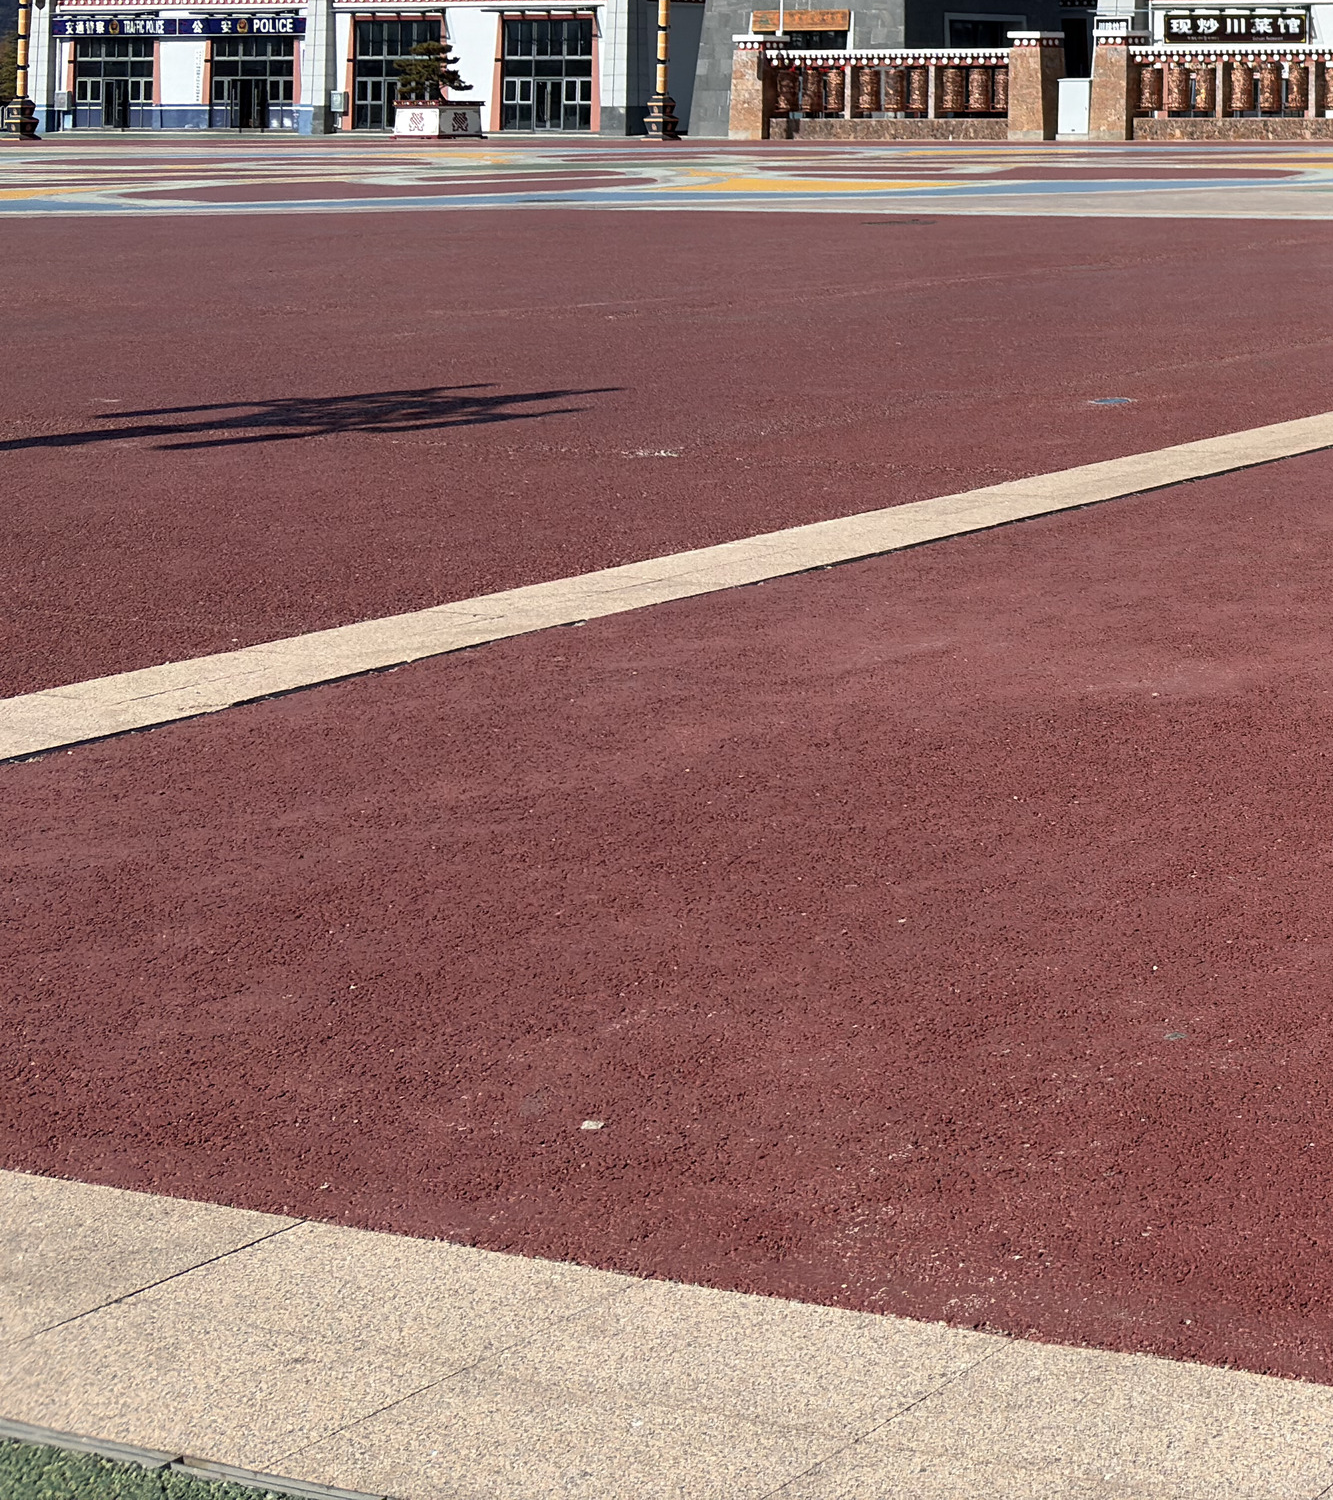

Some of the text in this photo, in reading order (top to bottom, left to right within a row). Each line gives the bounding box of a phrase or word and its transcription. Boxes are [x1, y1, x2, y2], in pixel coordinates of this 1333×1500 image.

[65, 20, 105, 35] 交通警察
[123, 20, 145, 34] TRAFFIC
[191, 19, 294, 34] 公安 POLICE
[1169, 17, 1301, 34] 现炒川菜馆
